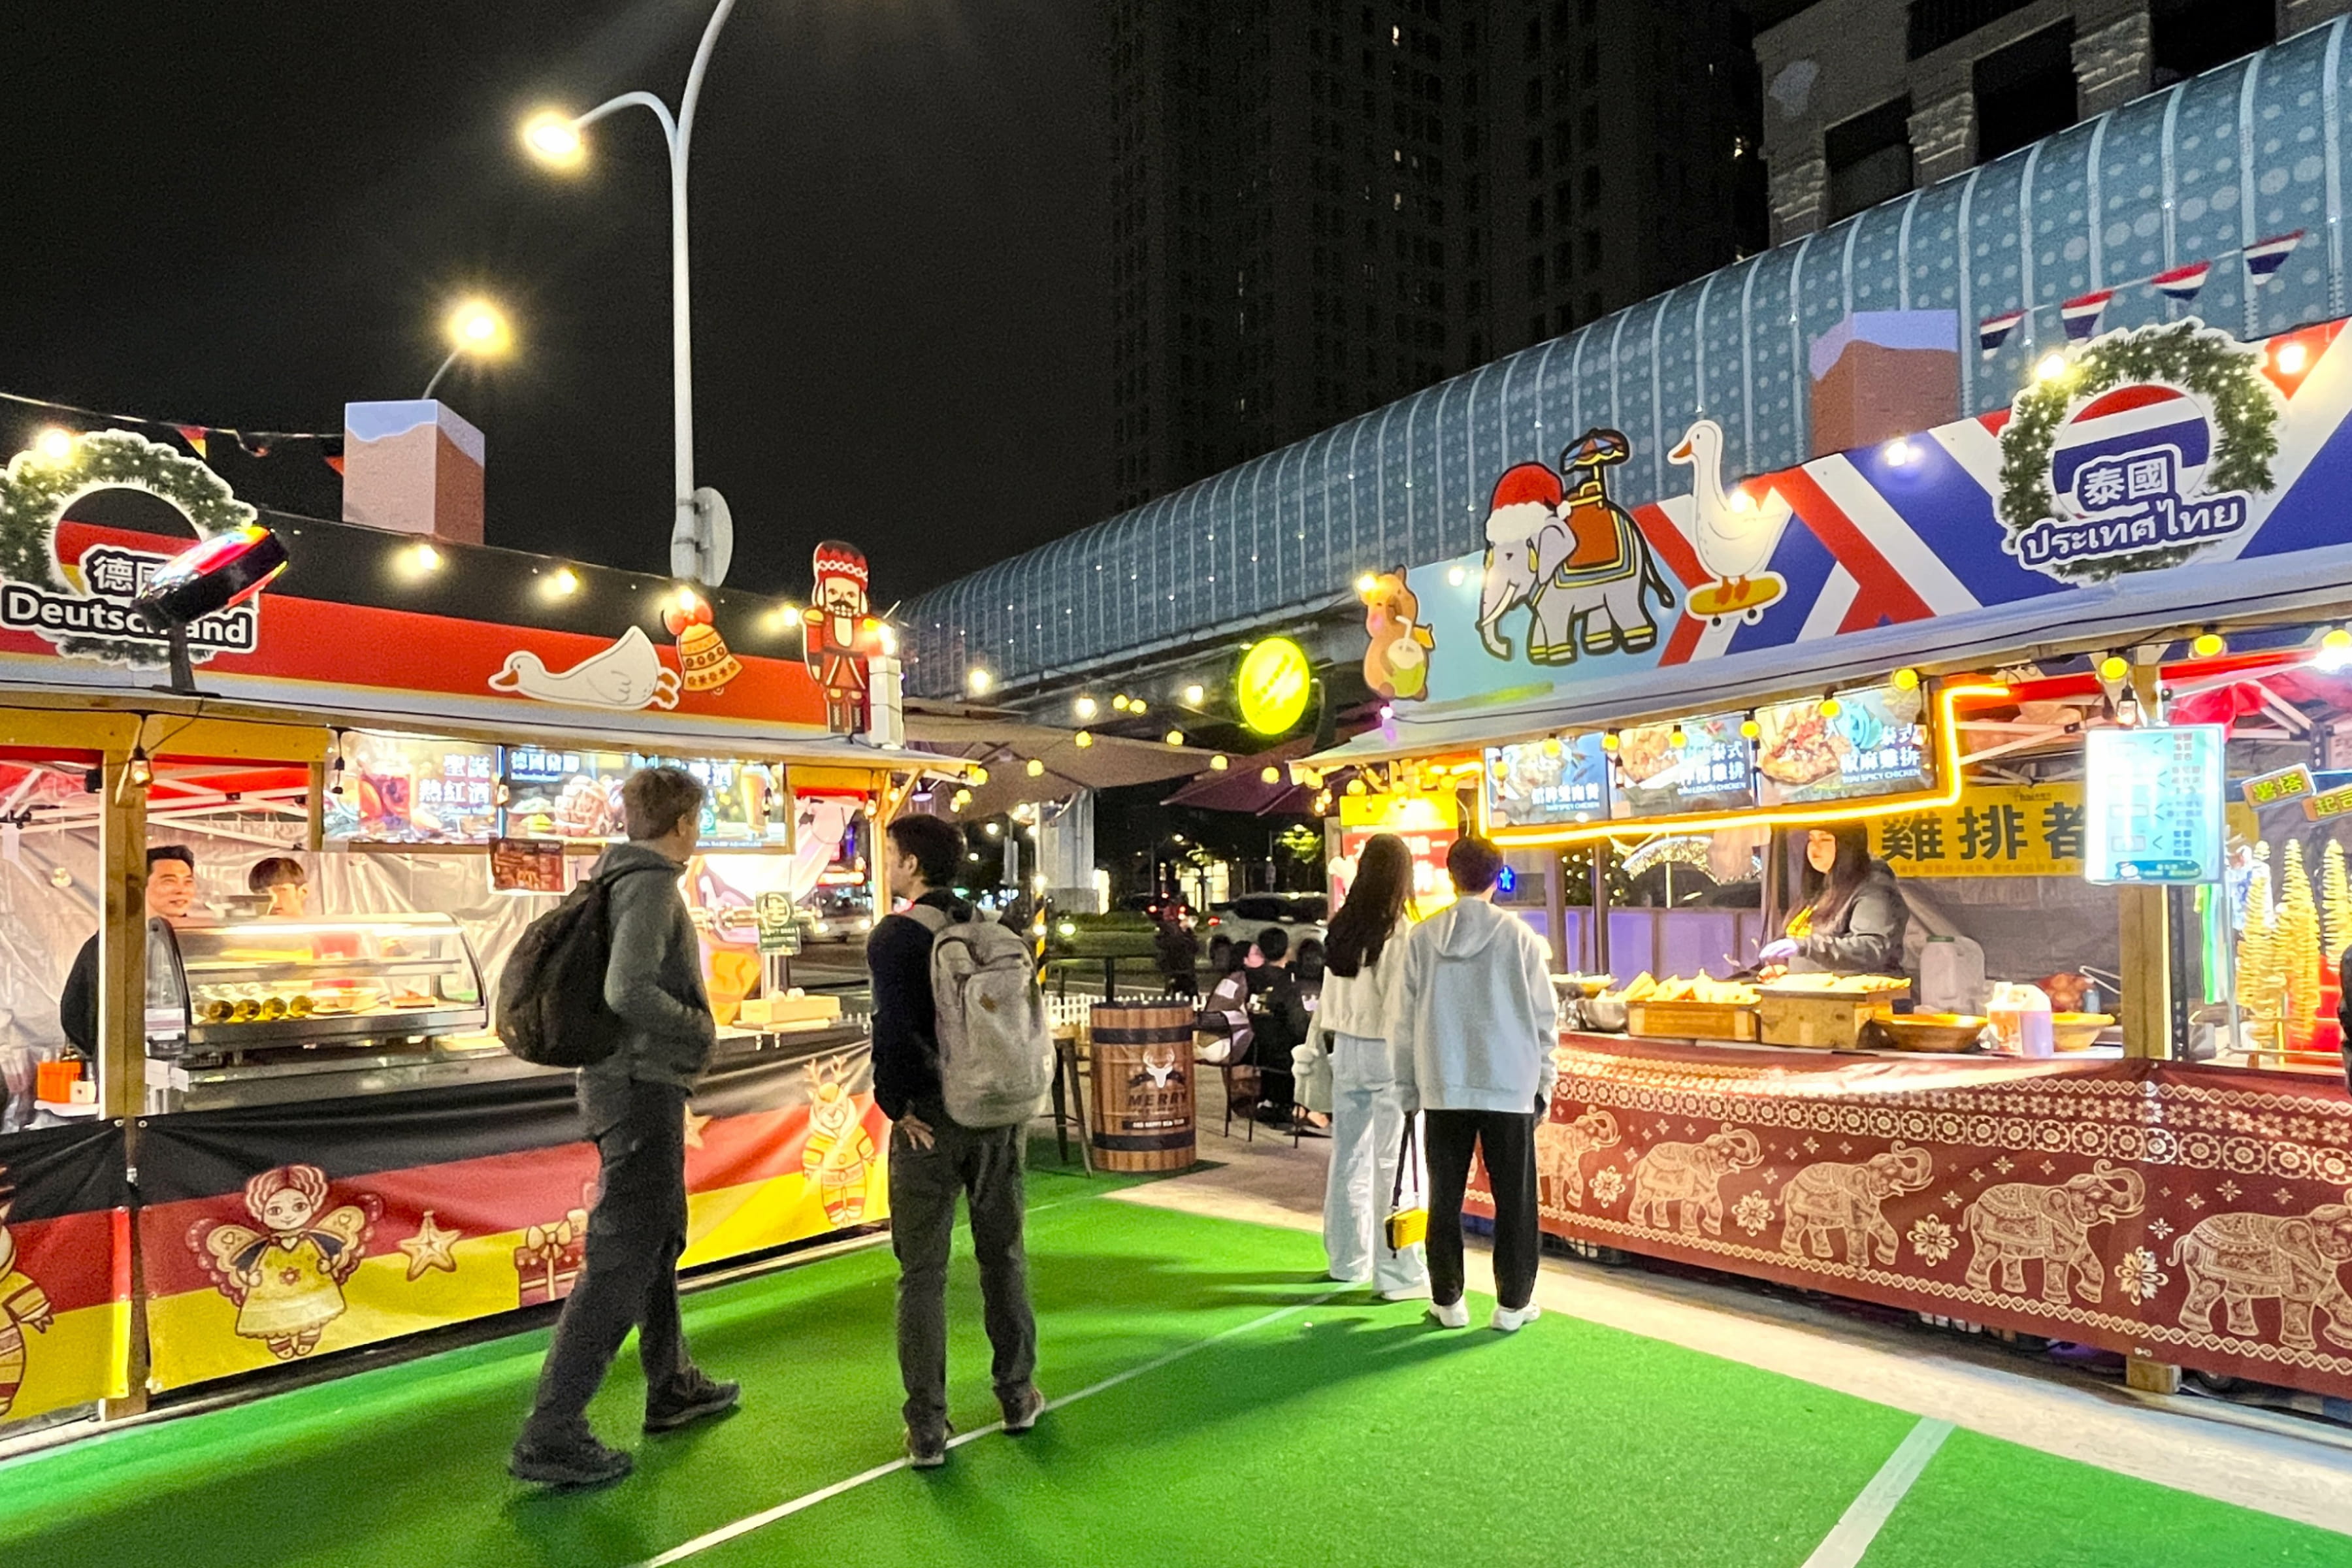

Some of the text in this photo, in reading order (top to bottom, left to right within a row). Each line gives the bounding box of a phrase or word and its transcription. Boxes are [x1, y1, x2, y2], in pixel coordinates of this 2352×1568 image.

[2085, 457, 2168, 505] 泰國
[8, 592, 246, 644] Deutscand
[1885, 769, 1921, 778] CHICKEN
[419, 778, 491, 804] 熱紅酒
[1716, 782, 1746, 791] CHICKEN
[1128, 1092, 1187, 1106] MERRY
